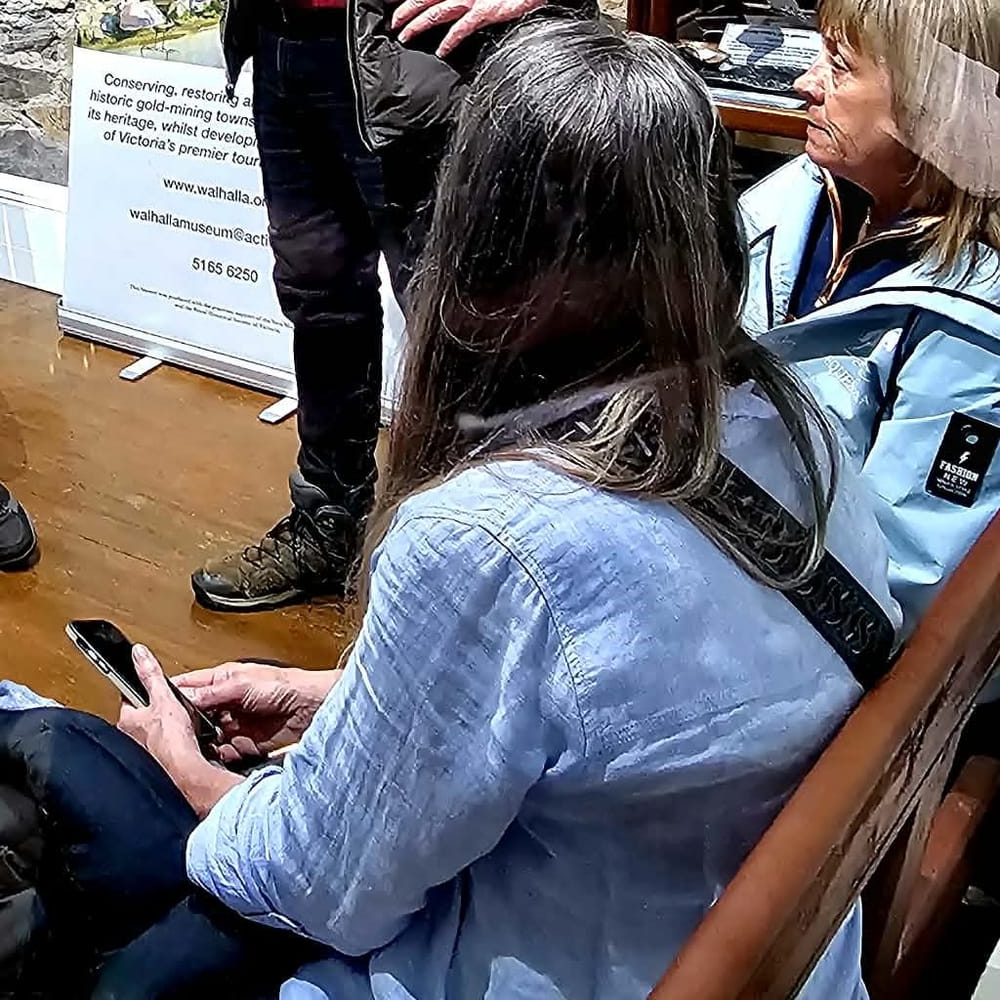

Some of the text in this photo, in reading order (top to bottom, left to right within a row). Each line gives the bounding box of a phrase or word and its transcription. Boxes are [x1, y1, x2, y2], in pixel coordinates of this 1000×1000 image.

[104, 73, 177, 98] Conserving,
[181, 87, 239, 108] restoring
[90, 89, 133, 108] historic
[136, 98, 213, 123] gold-mining
[87, 107, 101, 120] its
[103, 110, 157, 132] heritage,
[161, 121, 199, 137] whilst
[103, 129, 262, 168] of Victoria's premier tour
[191, 257, 259, 283] 5165 6250
[939, 460, 979, 483] FASHION
[942, 472, 968, 487] NEW
